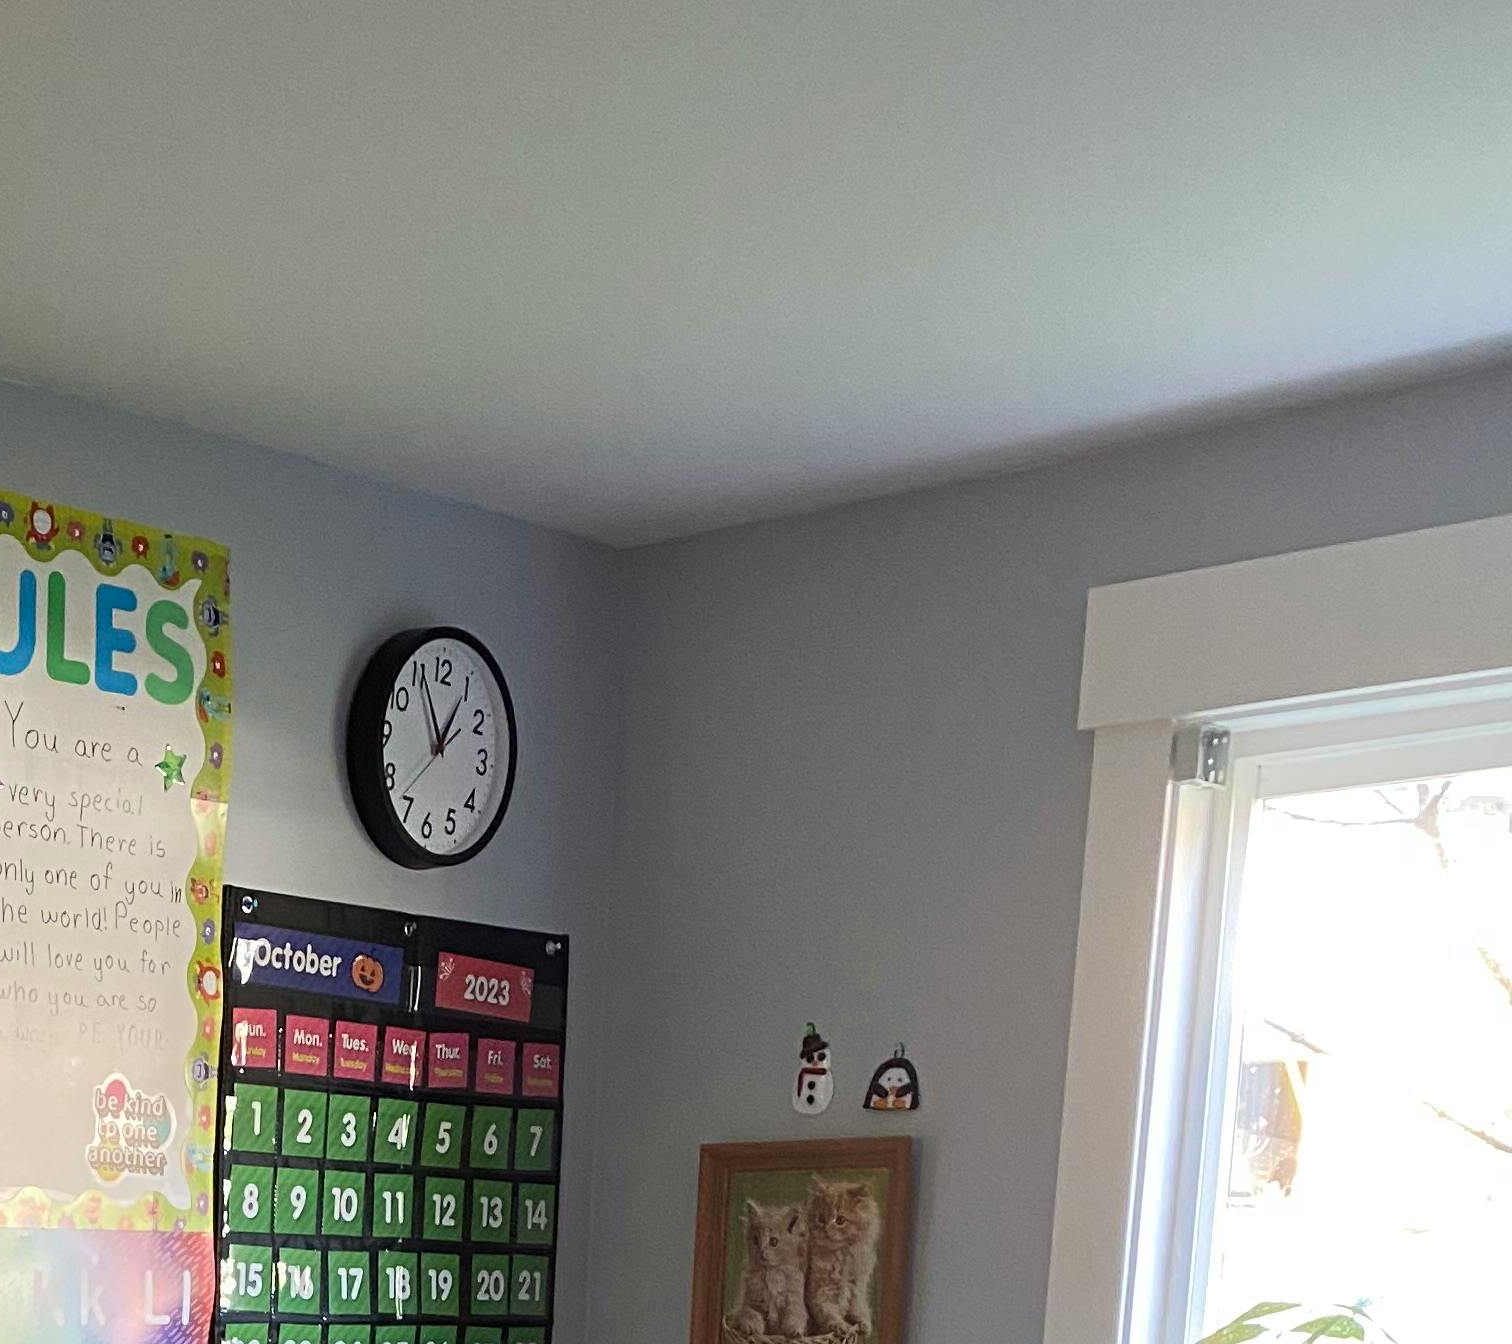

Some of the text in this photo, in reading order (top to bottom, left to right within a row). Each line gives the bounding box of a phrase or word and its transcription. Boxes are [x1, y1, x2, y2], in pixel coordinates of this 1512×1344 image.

[435, 657, 453, 686] 12
[5, 700, 142, 766] You are a
[473, 710, 484, 735] 2
[476, 749, 488, 776] 3
[9, 784, 55, 822] very
[69, 789, 143, 821] special
[78, 824, 136, 855] There
[150, 835, 165, 857] is
[45, 869, 79, 889] one
[90, 861, 112, 891] of
[125, 878, 163, 904] you
[172, 880, 182, 903] in
[41, 908, 108, 932] world!
[115, 901, 181, 943] People
[255, 937, 342, 977] October
[463, 974, 511, 1005] 2023
[293, 1029, 323, 1047] Mon.
[342, 1033, 369, 1052] Tues.
[488, 1050, 503, 1067] Fri.
[95, 1088, 164, 1117] be kind
[98, 1116, 158, 1143] to one
[296, 1109, 313, 1144] 2
[341, 1112, 356, 1147] 3
[88, 1146, 167, 1172] another
[290, 1185, 307, 1220] 9
[338, 1267, 363, 1300] 17
